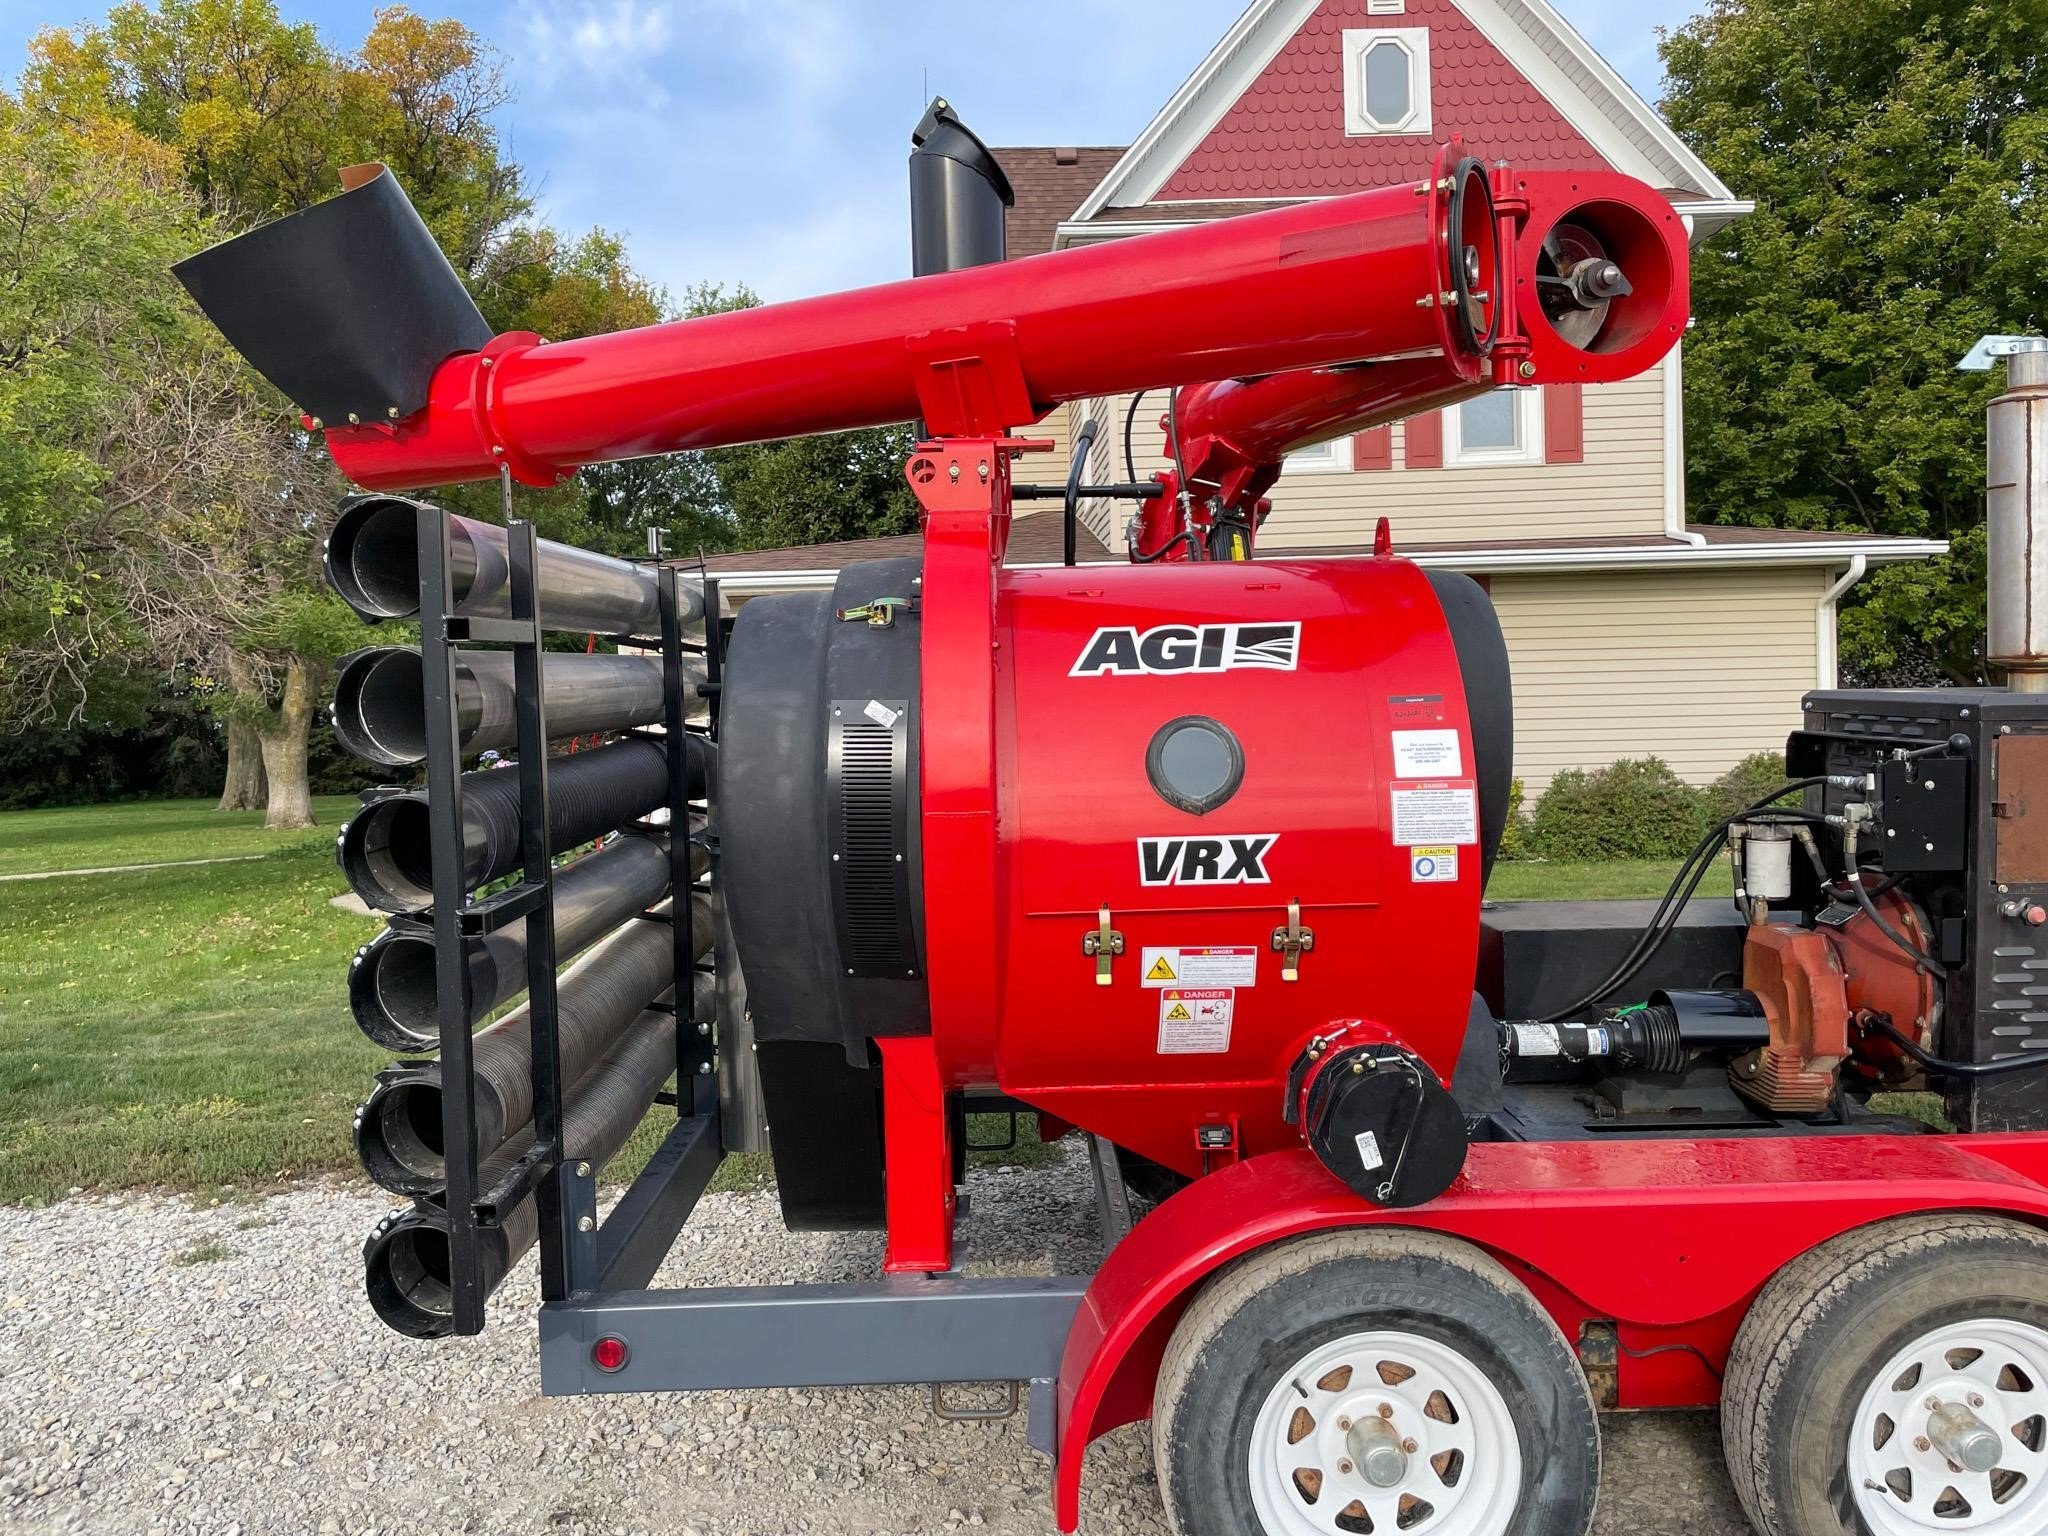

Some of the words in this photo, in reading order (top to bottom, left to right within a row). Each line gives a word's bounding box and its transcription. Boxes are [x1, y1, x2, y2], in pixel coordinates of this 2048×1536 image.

[1077, 627, 1226, 671] AGI
[1142, 839, 1270, 882] VRX
[1183, 991, 1226, 999] DANGER
